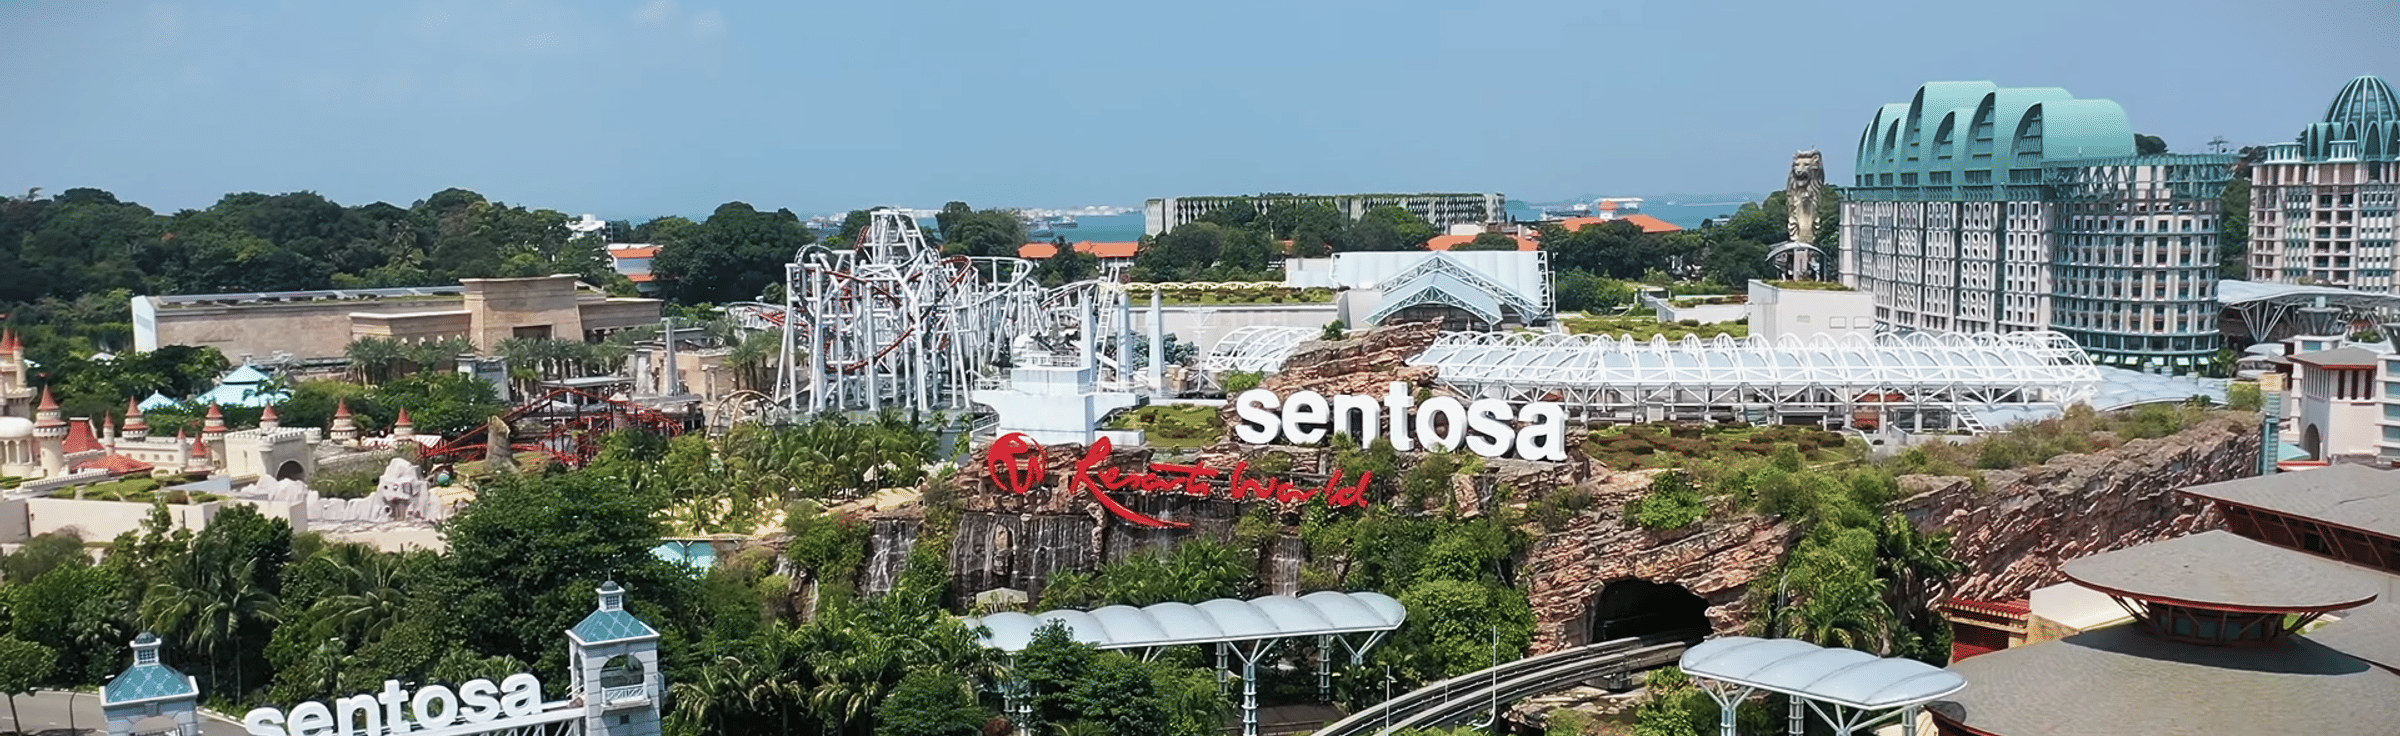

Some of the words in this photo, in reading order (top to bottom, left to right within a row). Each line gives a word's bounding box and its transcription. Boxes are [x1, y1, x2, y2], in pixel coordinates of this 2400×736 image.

[1235, 380, 1568, 462] sentosa
[1229, 461, 1374, 508] World
[245, 672, 543, 736] sentosa
